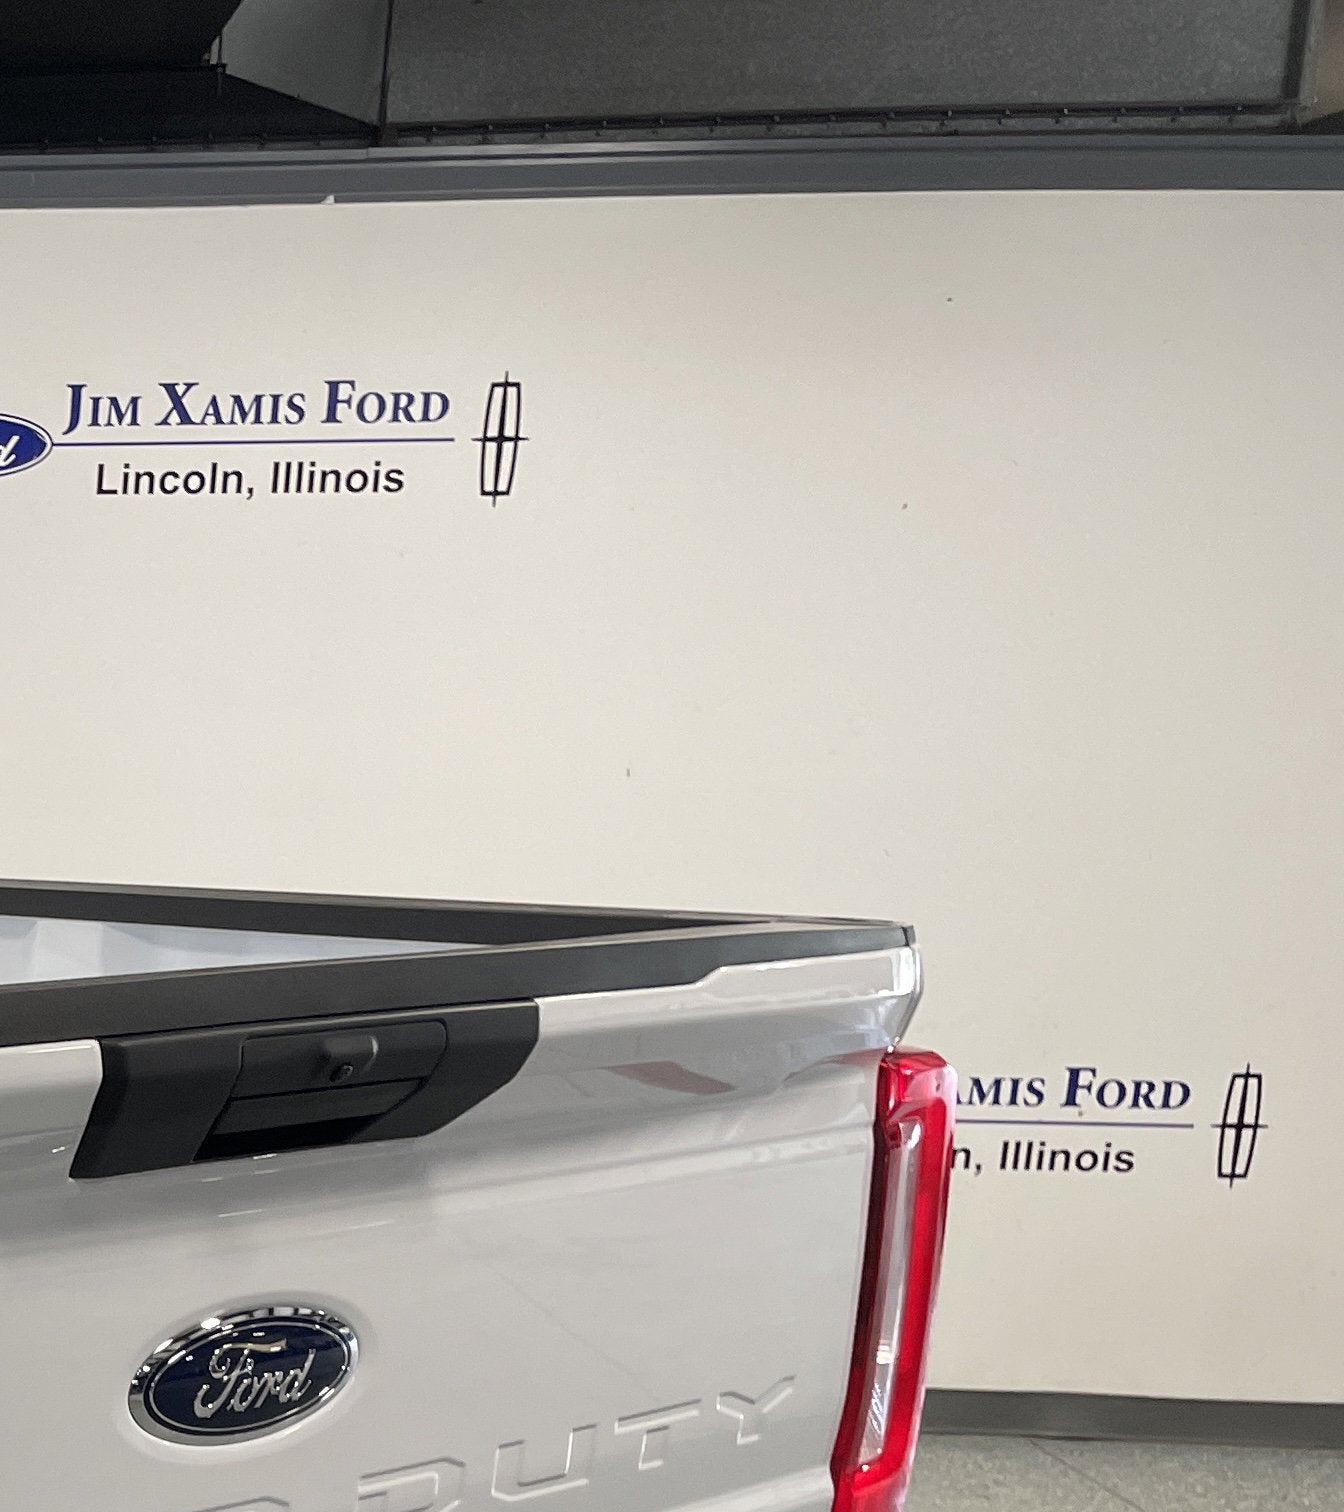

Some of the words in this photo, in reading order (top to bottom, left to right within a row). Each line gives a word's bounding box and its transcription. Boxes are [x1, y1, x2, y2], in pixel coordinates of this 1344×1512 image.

[62, 383, 142, 435] JIM
[155, 382, 306, 426] XAMIS
[321, 380, 450, 424] FORD
[96, 461, 255, 500] Lincoln,
[271, 460, 405, 494] Illinois
[957, 1076, 1046, 1107] MIS
[1060, 1066, 1192, 1109] FORD
[998, 1140, 1135, 1173] Illinois
[194, 1338, 316, 1418] Ford
